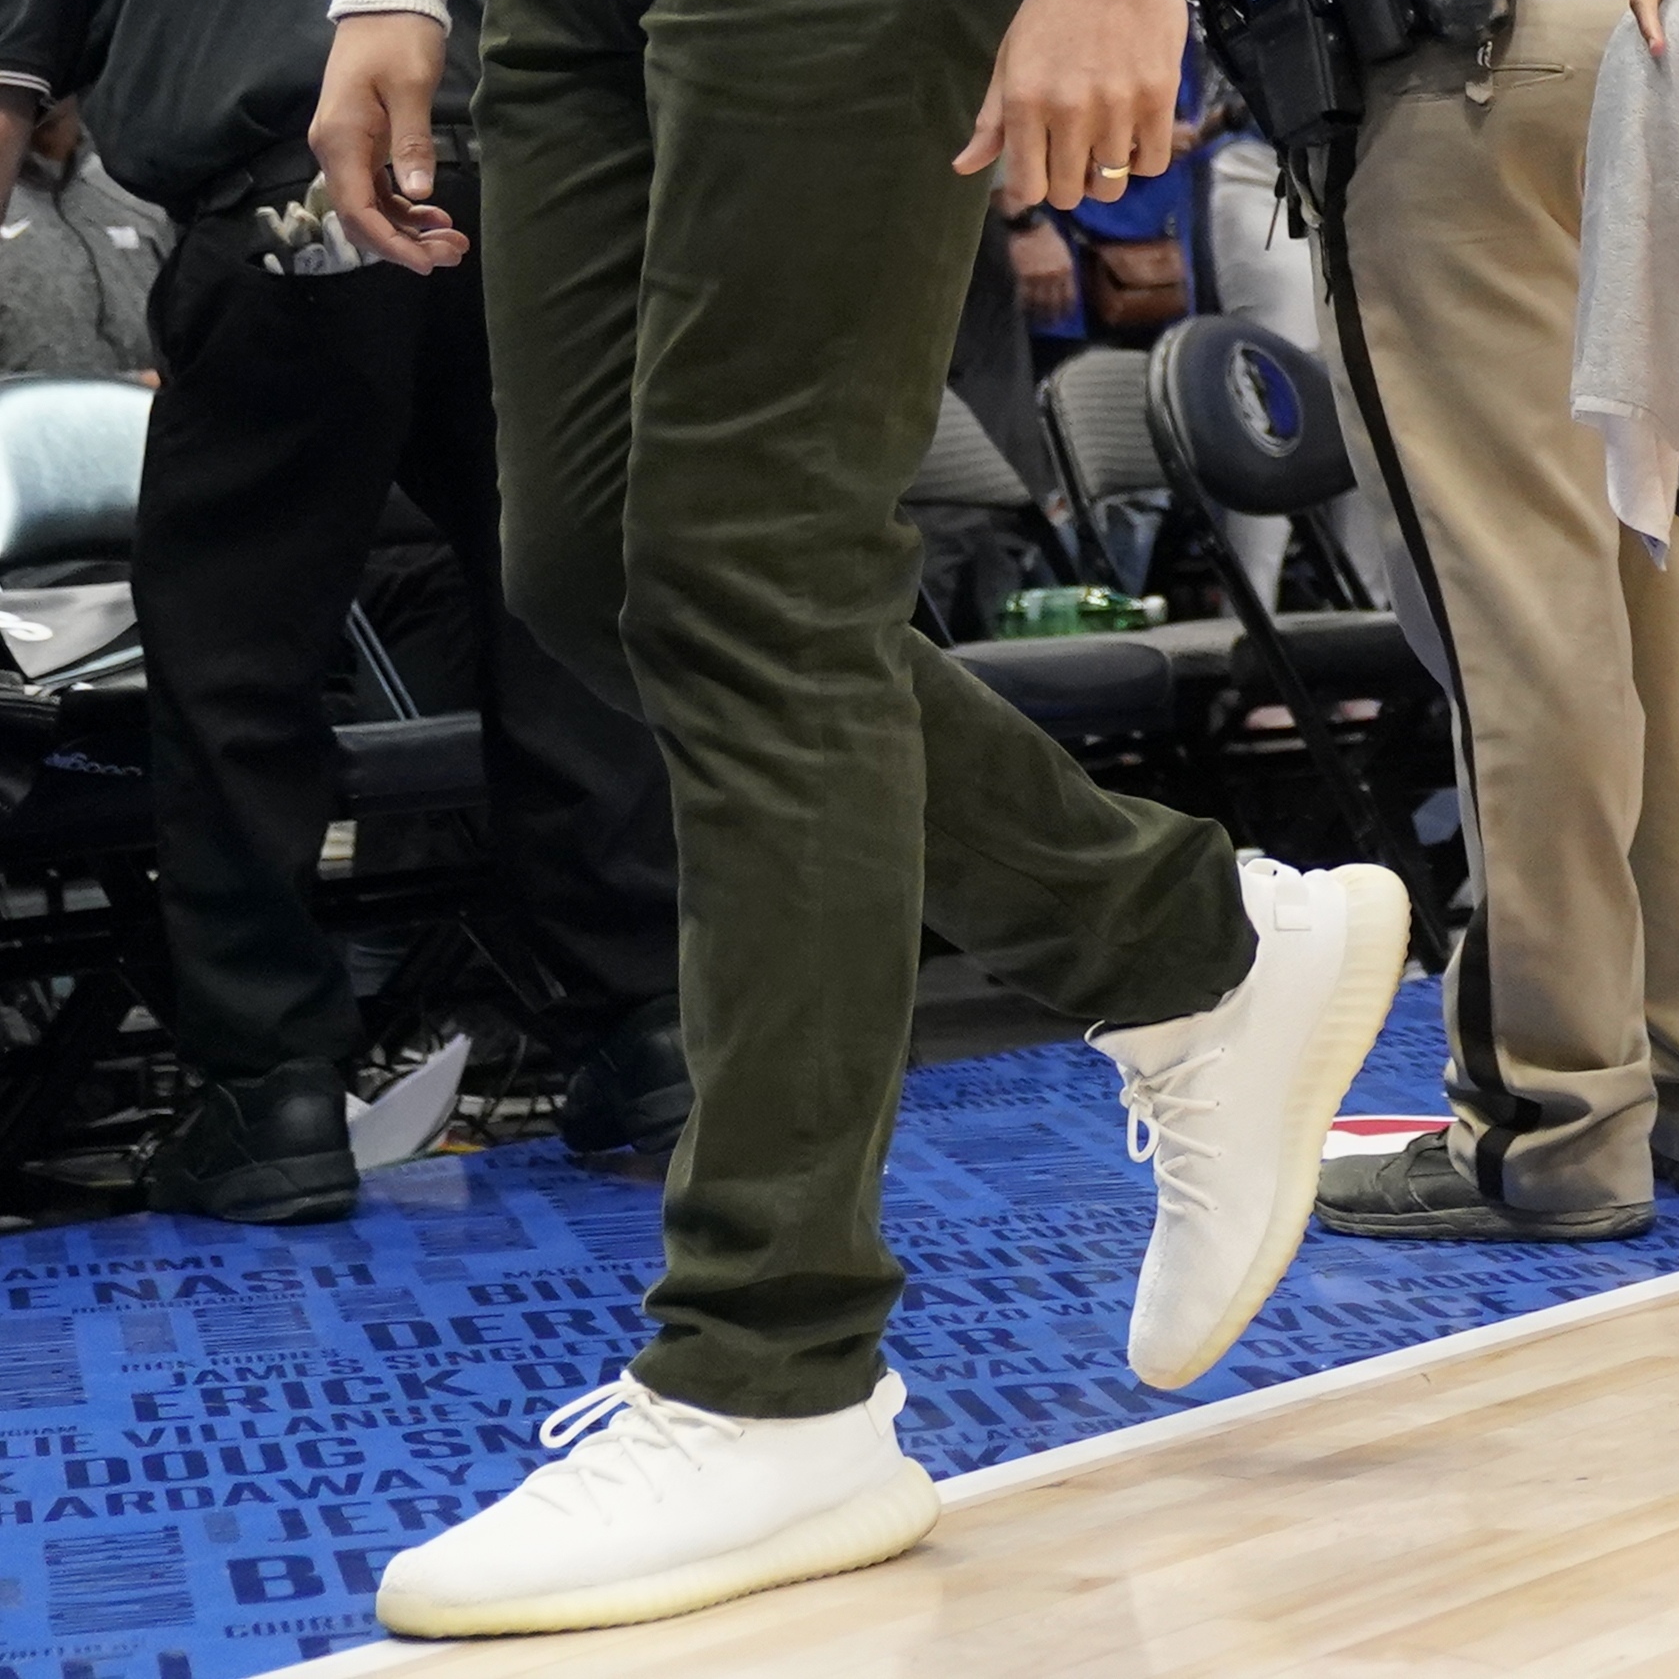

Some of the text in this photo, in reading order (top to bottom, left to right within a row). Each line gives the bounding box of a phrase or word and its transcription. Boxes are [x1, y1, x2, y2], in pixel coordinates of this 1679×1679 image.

[92, 1263, 376, 1305] NASH
[1252, 1288, 1540, 1333] VINCE
[171, 1357, 366, 1387] JAMES
[130, 1368, 483, 1423] ERICK
[63, 1436, 367, 1490] DOUG
